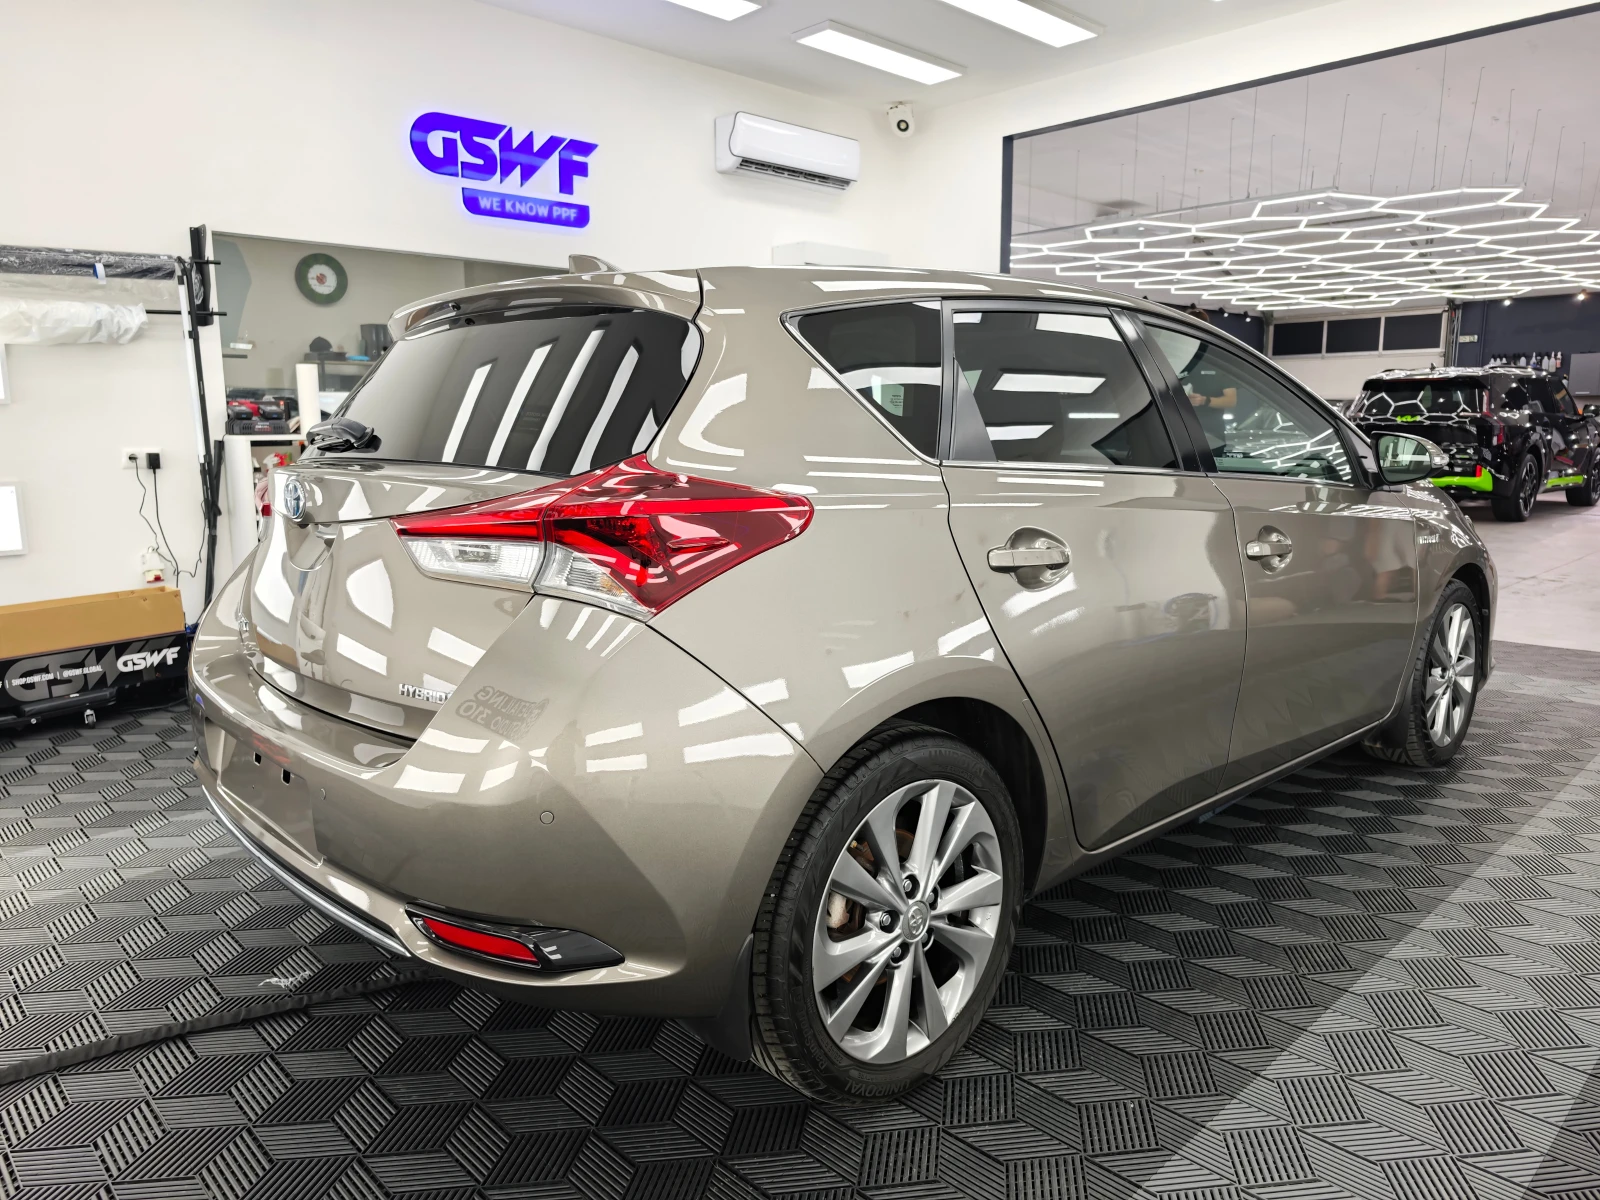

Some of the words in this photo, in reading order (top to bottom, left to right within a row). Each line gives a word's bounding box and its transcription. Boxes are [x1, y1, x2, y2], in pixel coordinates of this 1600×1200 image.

[409, 112, 599, 196] GSWF
[478, 196, 501, 211] WE
[505, 199, 549, 218] KNOW
[552, 206, 578, 222] PPF
[117, 646, 181, 673] GSWF
[12, 672, 55, 687] SHOP.GSWF.COM
[399, 683, 446, 705] HYBRID
[844, 1077, 911, 1097] UNIROYAL
